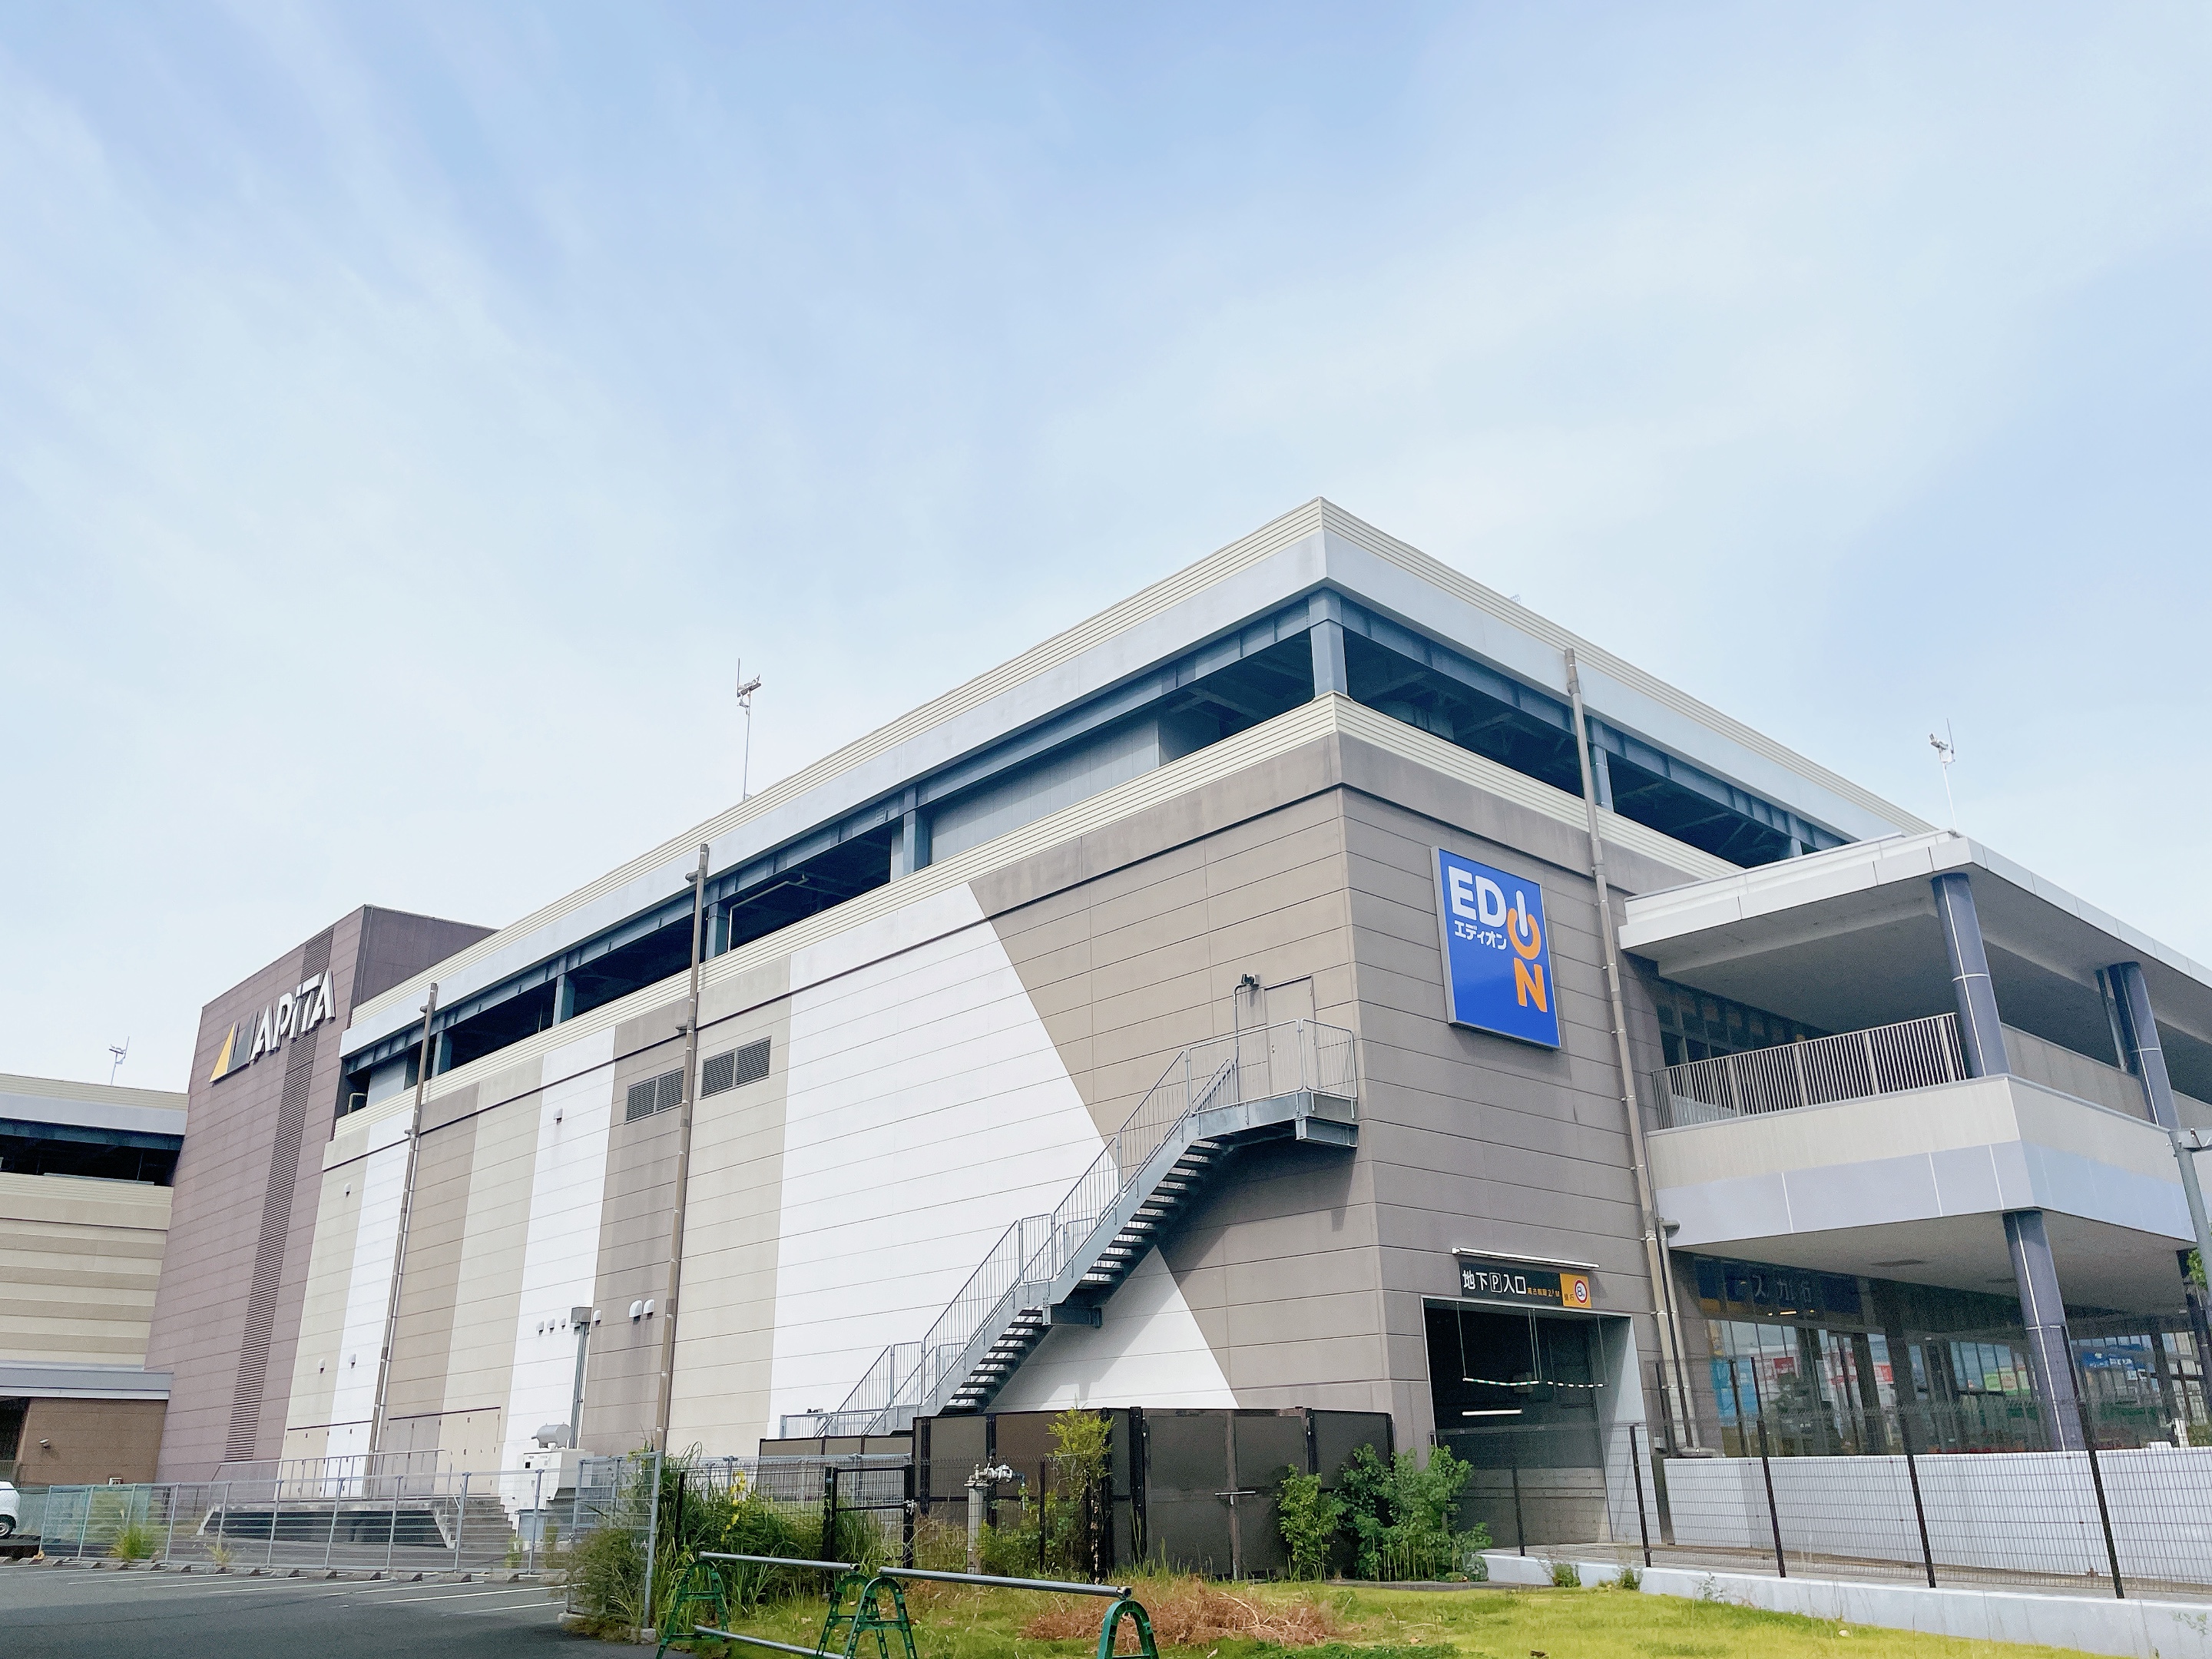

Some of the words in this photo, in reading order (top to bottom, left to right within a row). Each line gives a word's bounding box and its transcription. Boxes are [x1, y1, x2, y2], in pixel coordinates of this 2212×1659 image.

[1454, 919, 1507, 950] エディオン
